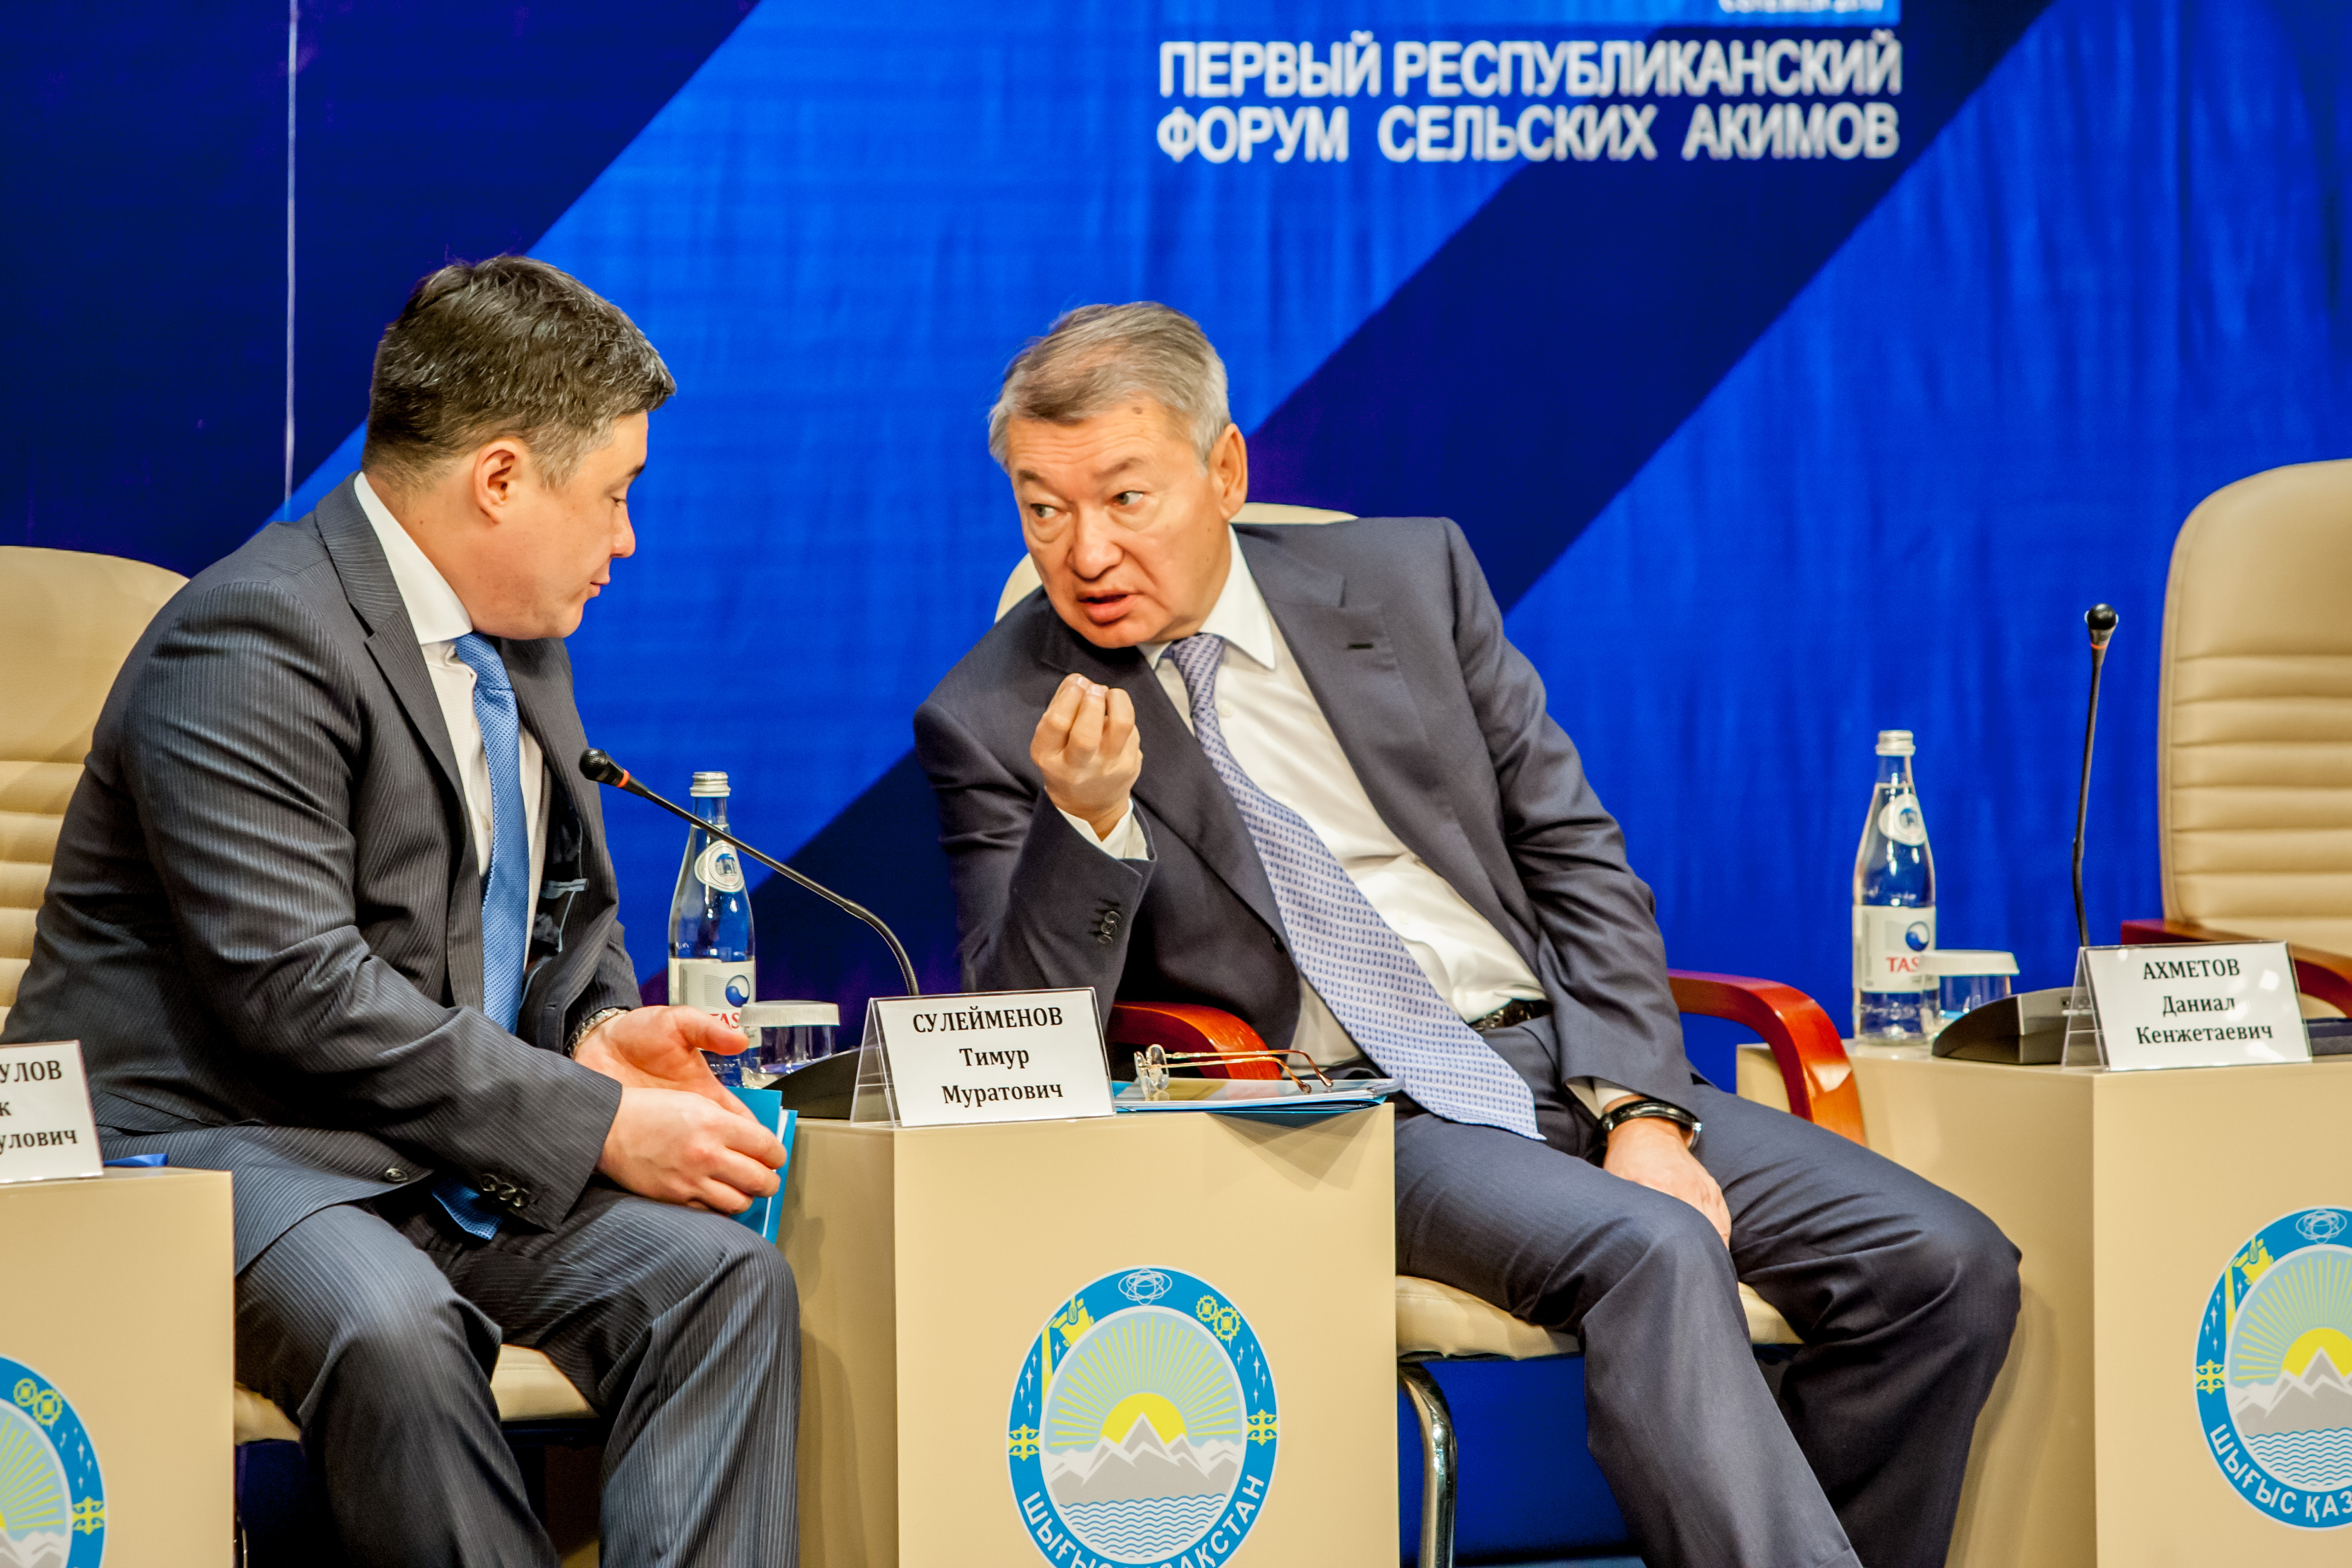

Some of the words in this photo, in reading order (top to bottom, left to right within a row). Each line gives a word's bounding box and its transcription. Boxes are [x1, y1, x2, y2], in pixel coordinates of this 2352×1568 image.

[1159, 30, 1382, 98] ПЕРВЫЙ
[1393, 29, 1901, 97] РЕСПУБЛИКАНСКИЙ
[1156, 105, 1349, 163] ФОРУМ
[1377, 105, 1658, 162] СЕЛЬСКИХ
[1682, 102, 1899, 160] АКИМОВ
[2143, 958, 2241, 980] АХМЕТОВ
[913, 1005, 1063, 1033] СУЛЕЙМЕНОВ
[2163, 996, 2236, 1018] Даниал
[2135, 1025, 2273, 1044] Кенжетаевич
[959, 1048, 1030, 1070] Тимур
[941, 1083, 1064, 1108] Муратович
[2209, 1423, 2297, 1514] ШЫҒЫС
[1022, 1491, 1114, 1568] ШЫҒЫ
